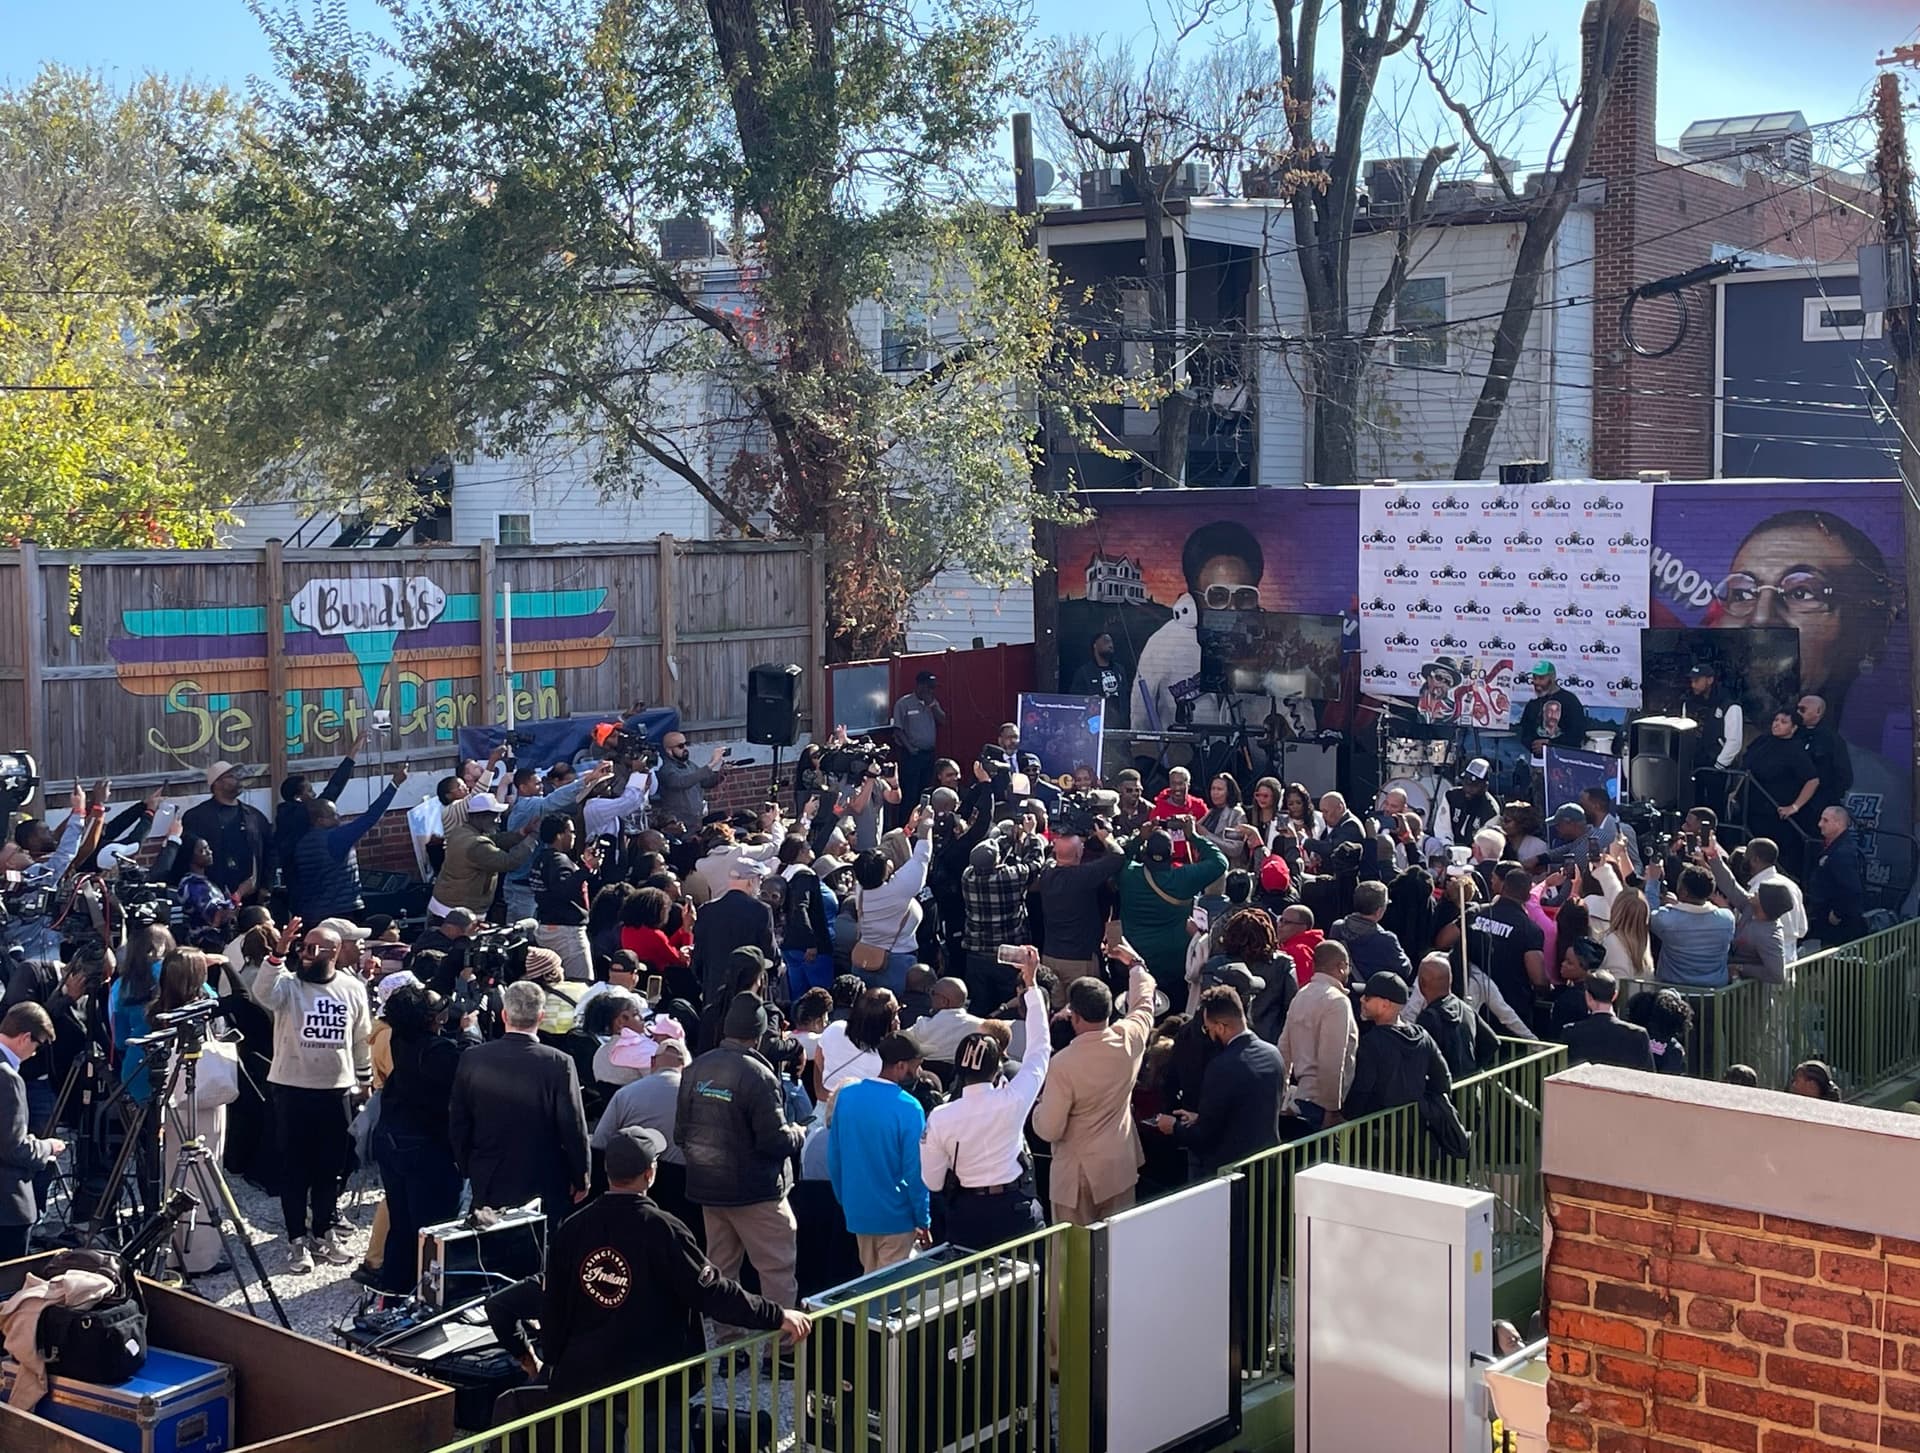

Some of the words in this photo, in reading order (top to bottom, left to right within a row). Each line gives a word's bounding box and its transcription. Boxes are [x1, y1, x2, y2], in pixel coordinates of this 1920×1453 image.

[1472, 916, 1514, 938] SECURITY
[317, 1000, 347, 1015] the
[306, 1014, 347, 1028] mus
[303, 1027, 345, 1040] eum
